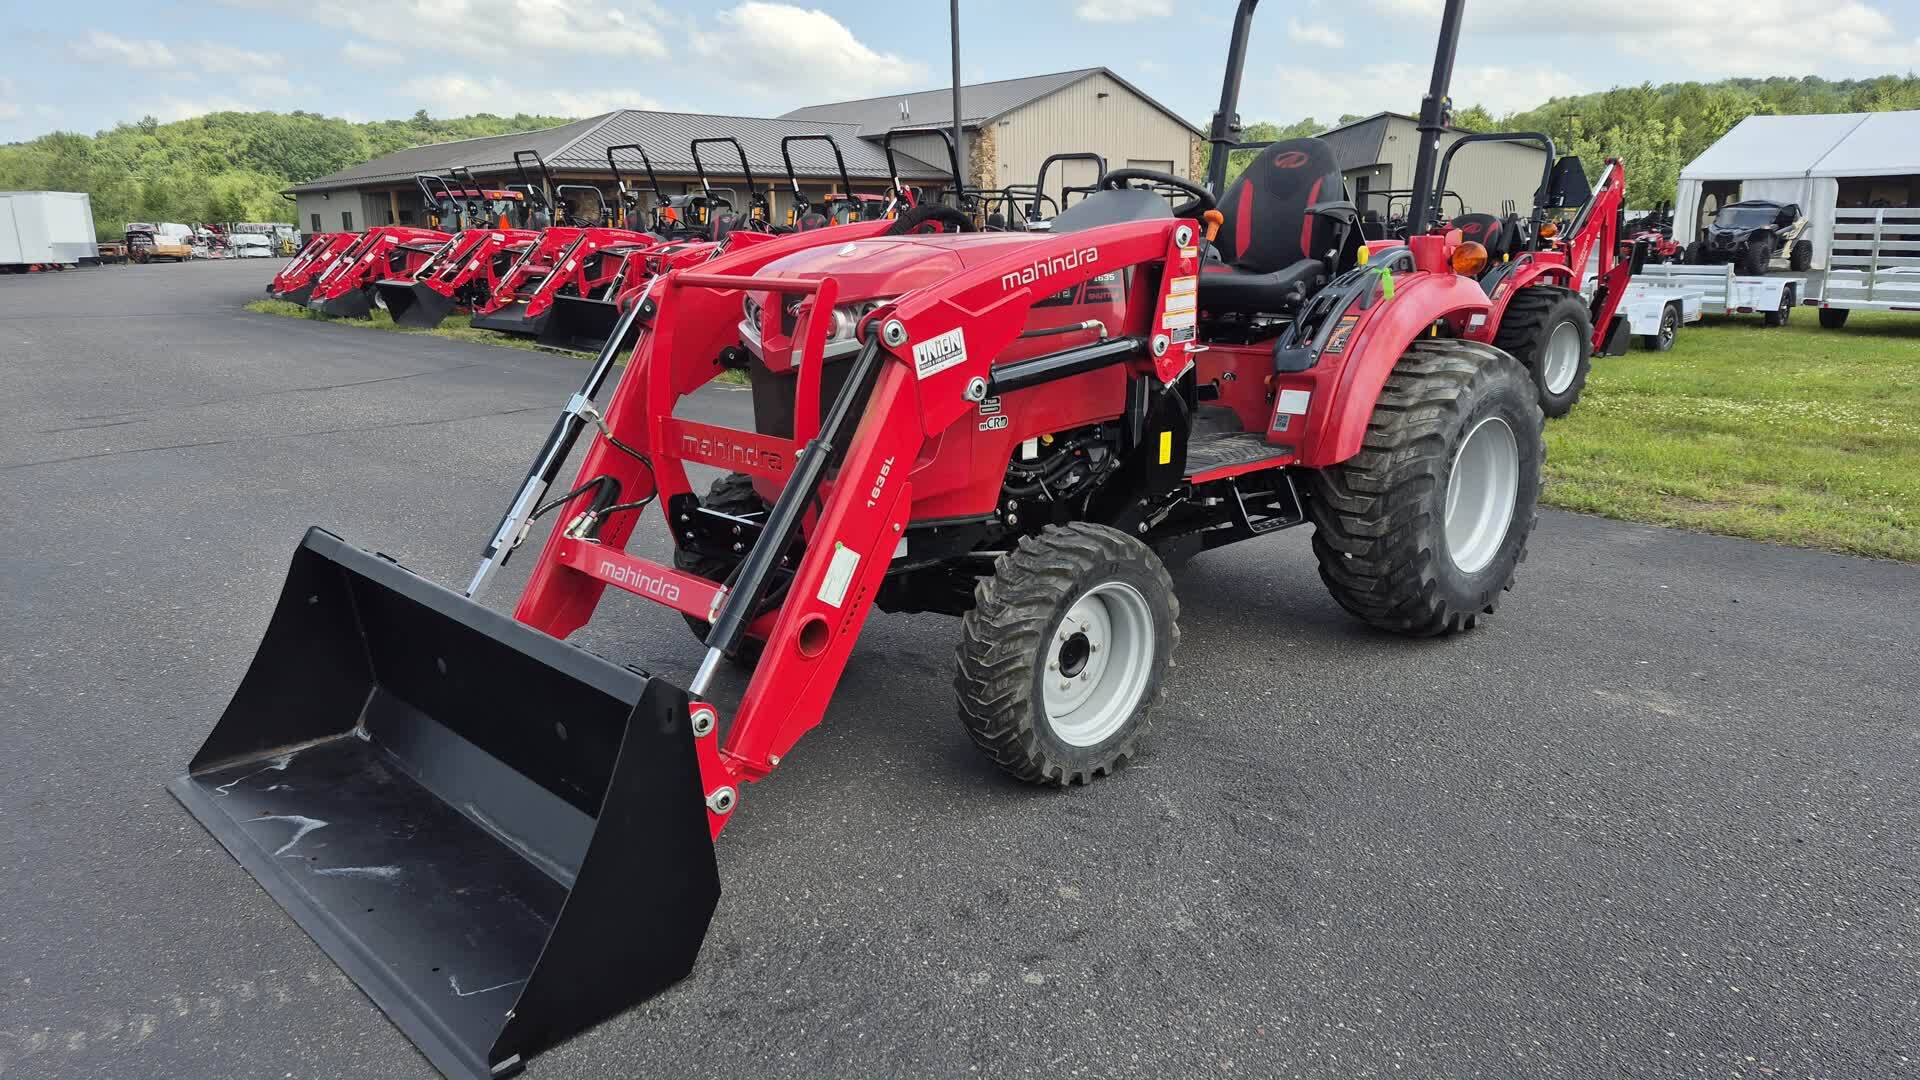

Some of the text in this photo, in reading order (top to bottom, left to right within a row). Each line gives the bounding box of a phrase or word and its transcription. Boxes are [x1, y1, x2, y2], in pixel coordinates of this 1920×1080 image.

[1001, 247, 1099, 291] mahindra
[917, 331, 962, 363] UNION
[682, 434, 782, 471] mahindra
[867, 456, 895, 507] 1635L
[600, 561, 680, 602] mahindra
